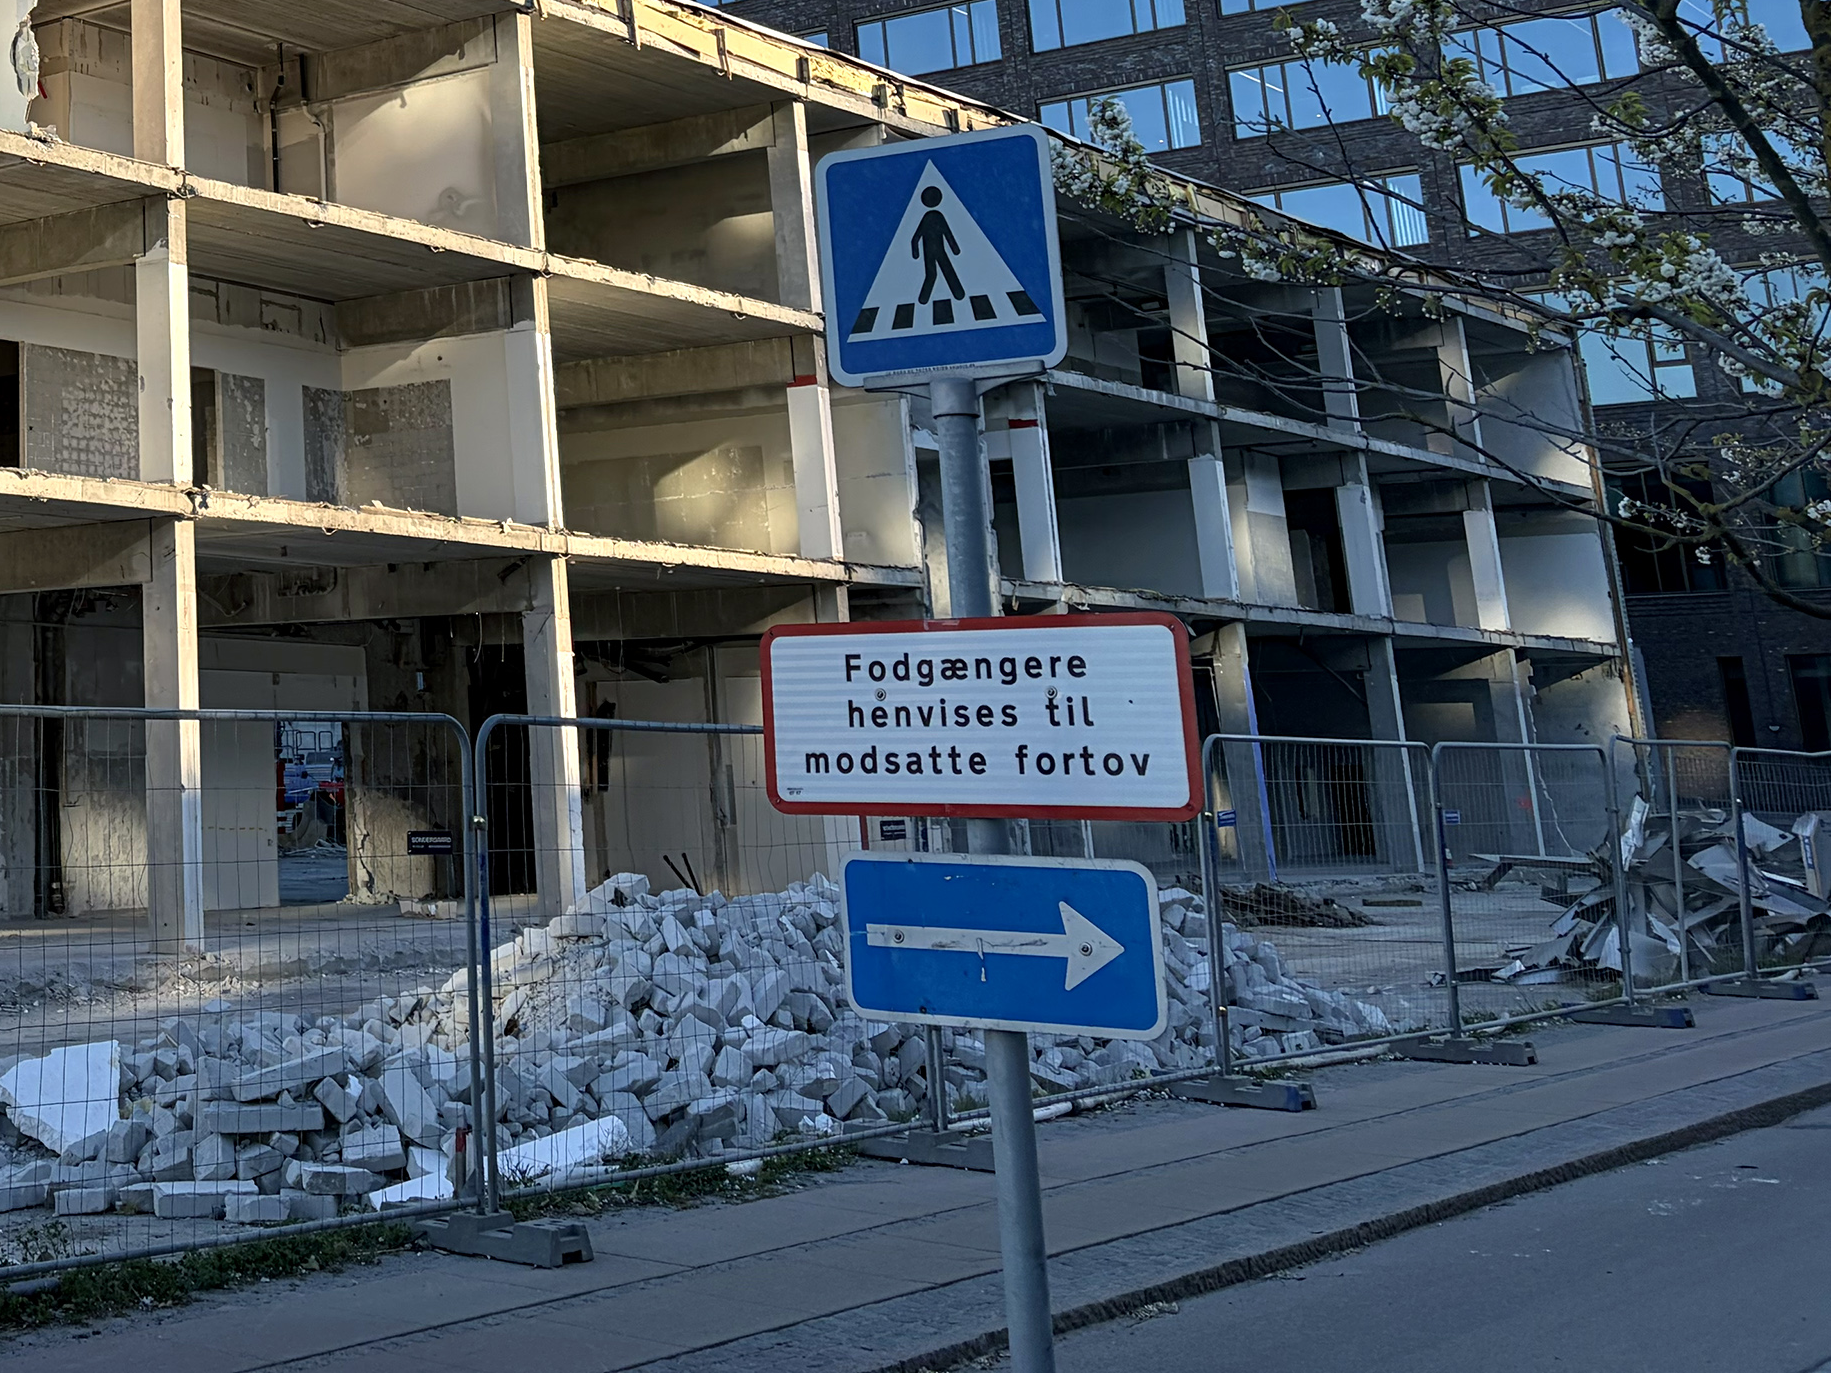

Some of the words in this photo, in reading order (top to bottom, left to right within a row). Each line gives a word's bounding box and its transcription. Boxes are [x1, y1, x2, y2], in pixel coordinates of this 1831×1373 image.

[844, 652, 1087, 686] Fodgængere
[847, 699, 1018, 728] henvises
[1044, 694, 1095, 728] til
[805, 745, 987, 775] modsatte
[1014, 744, 1150, 776] fortov
